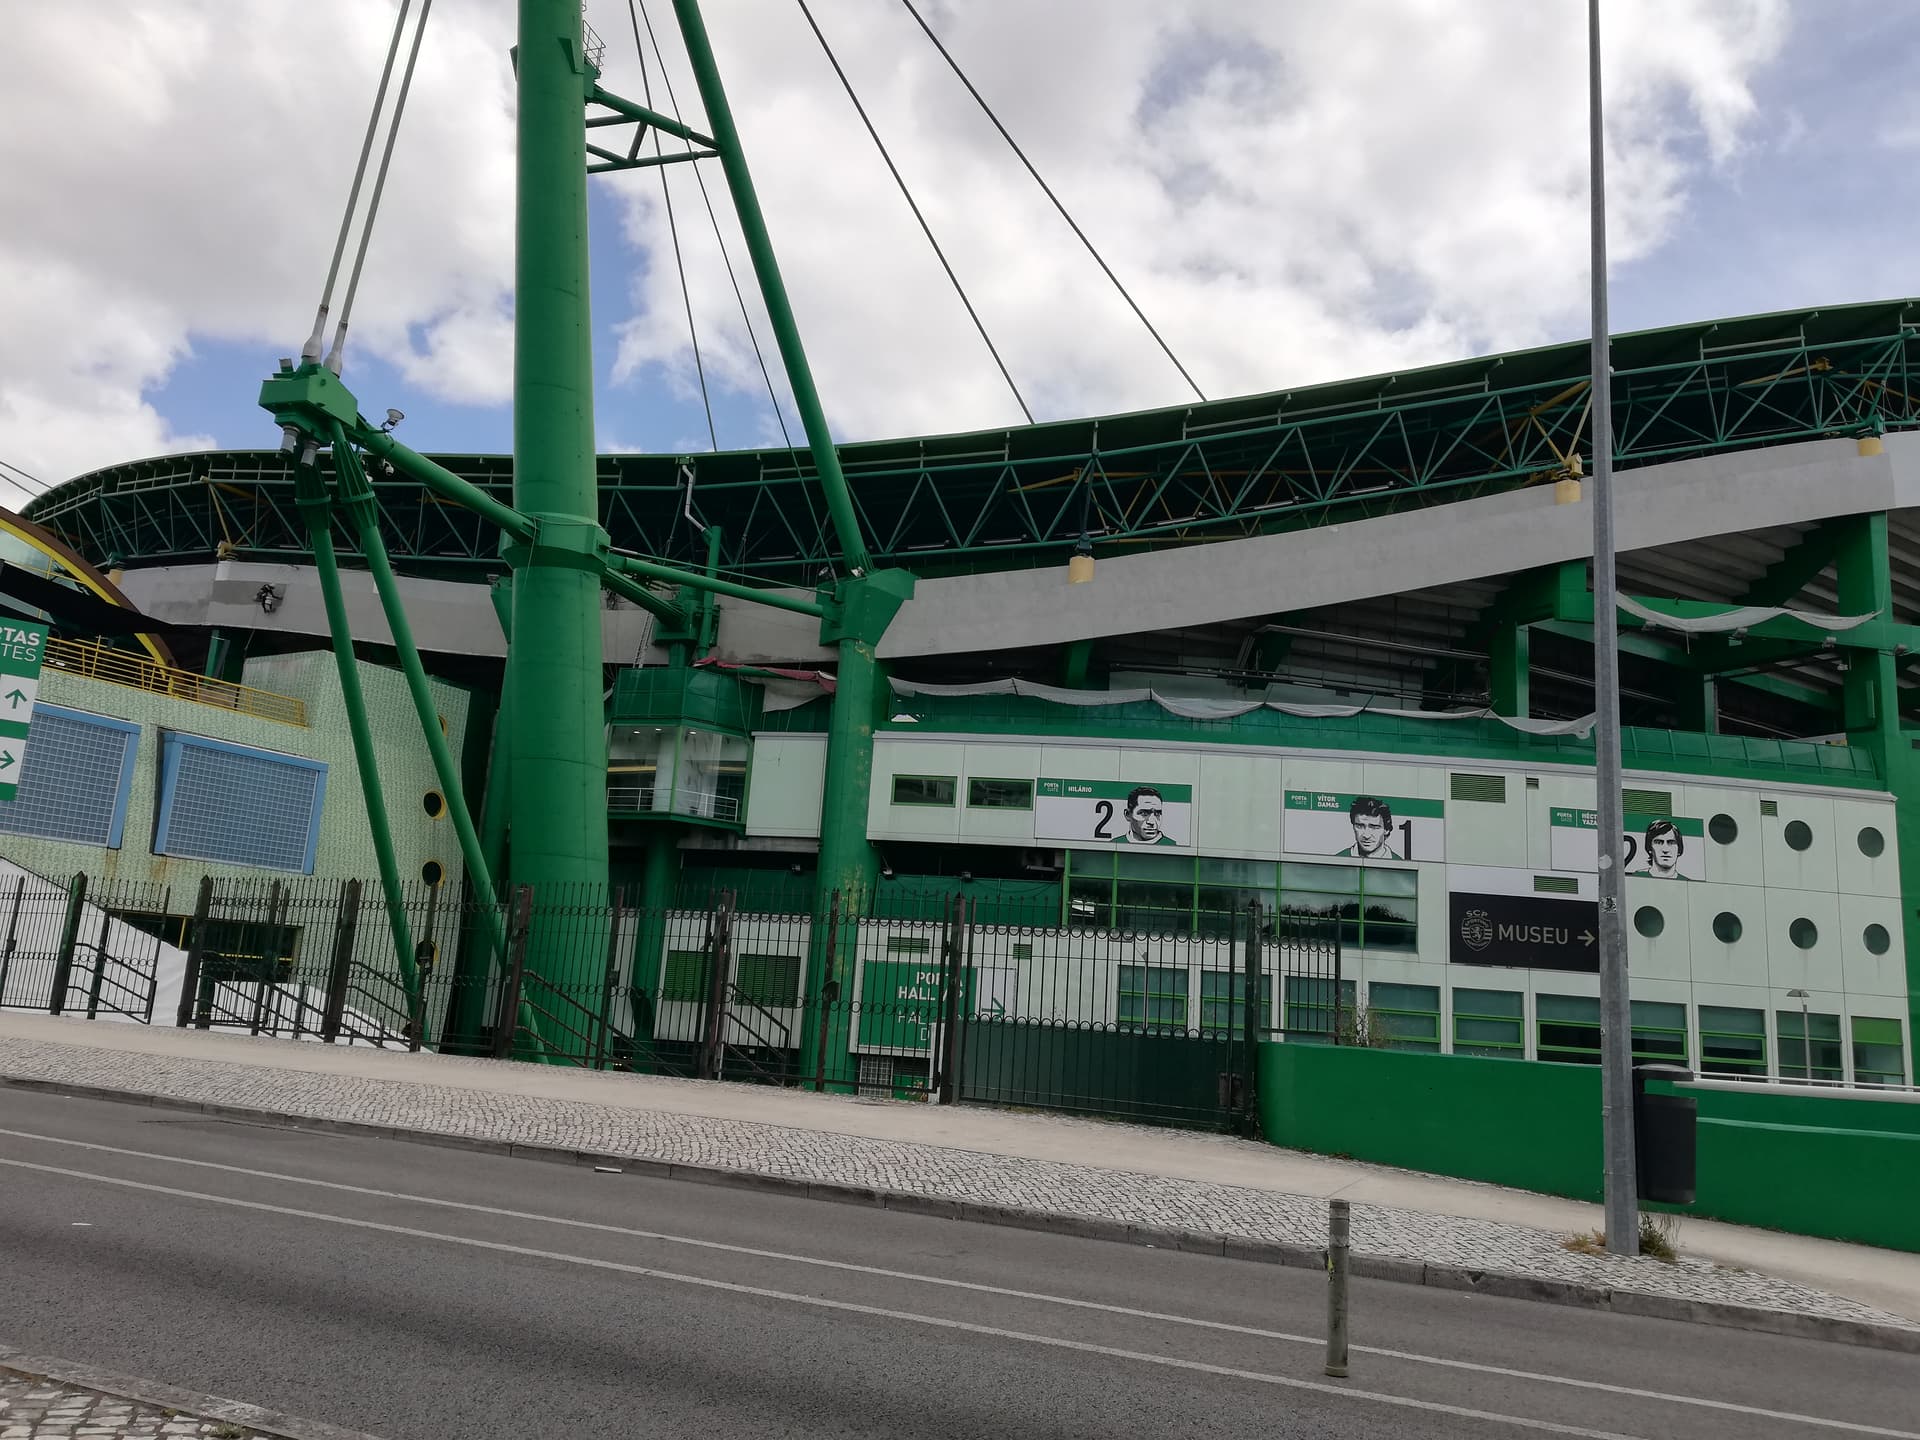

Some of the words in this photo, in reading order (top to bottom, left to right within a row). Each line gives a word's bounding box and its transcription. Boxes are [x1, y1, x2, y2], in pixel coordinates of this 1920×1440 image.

[1, 643, 36, 662] TES
[1068, 785, 1092, 793] HILÁRIO
[1317, 801, 1340, 809] DAMAS
[1094, 801, 1113, 838] 2
[1399, 820, 1412, 860] 1
[1498, 924, 1568, 944] MUSEU
